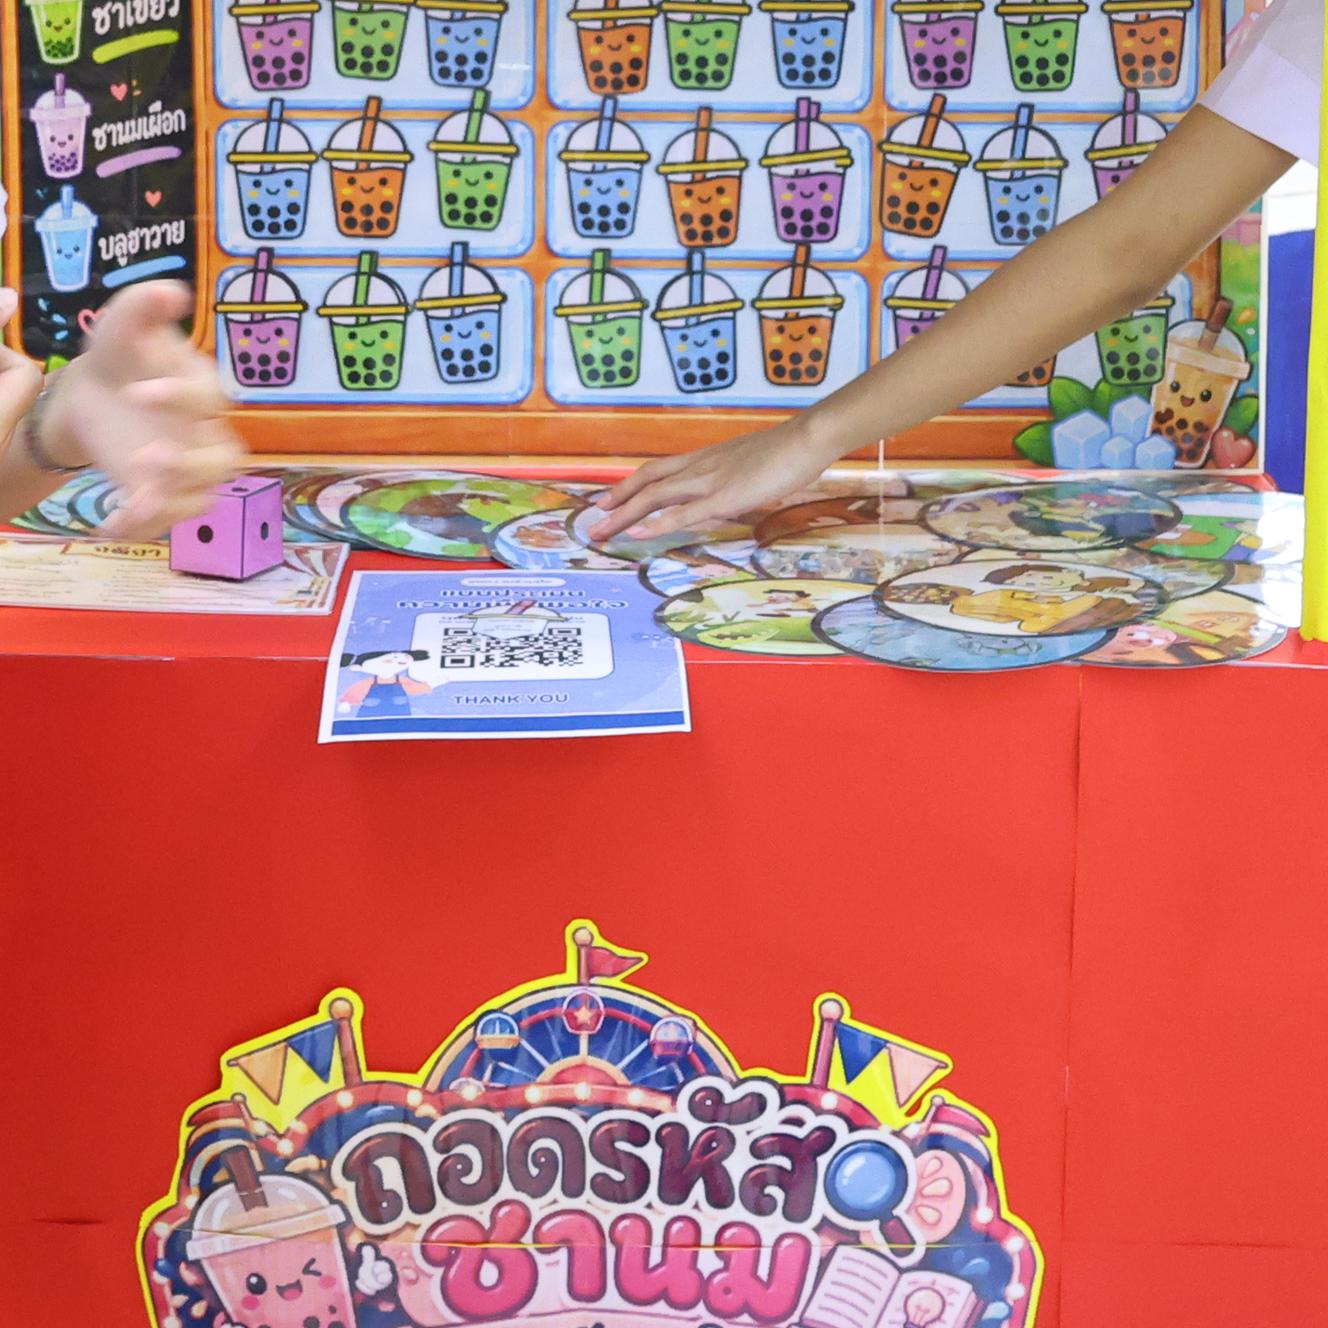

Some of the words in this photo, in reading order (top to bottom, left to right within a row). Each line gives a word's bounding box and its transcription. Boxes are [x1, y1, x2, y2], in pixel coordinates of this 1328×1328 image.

[93, 101, 186, 150] ชานมเผือก
[98, 218, 186, 267] บลูฮาวาย
[453, 694, 520, 706] THANK
[525, 692, 570, 704] YOU
[340, 1084, 834, 1225] ถอดรหัส
[420, 1205, 811, 1324] ชานม
